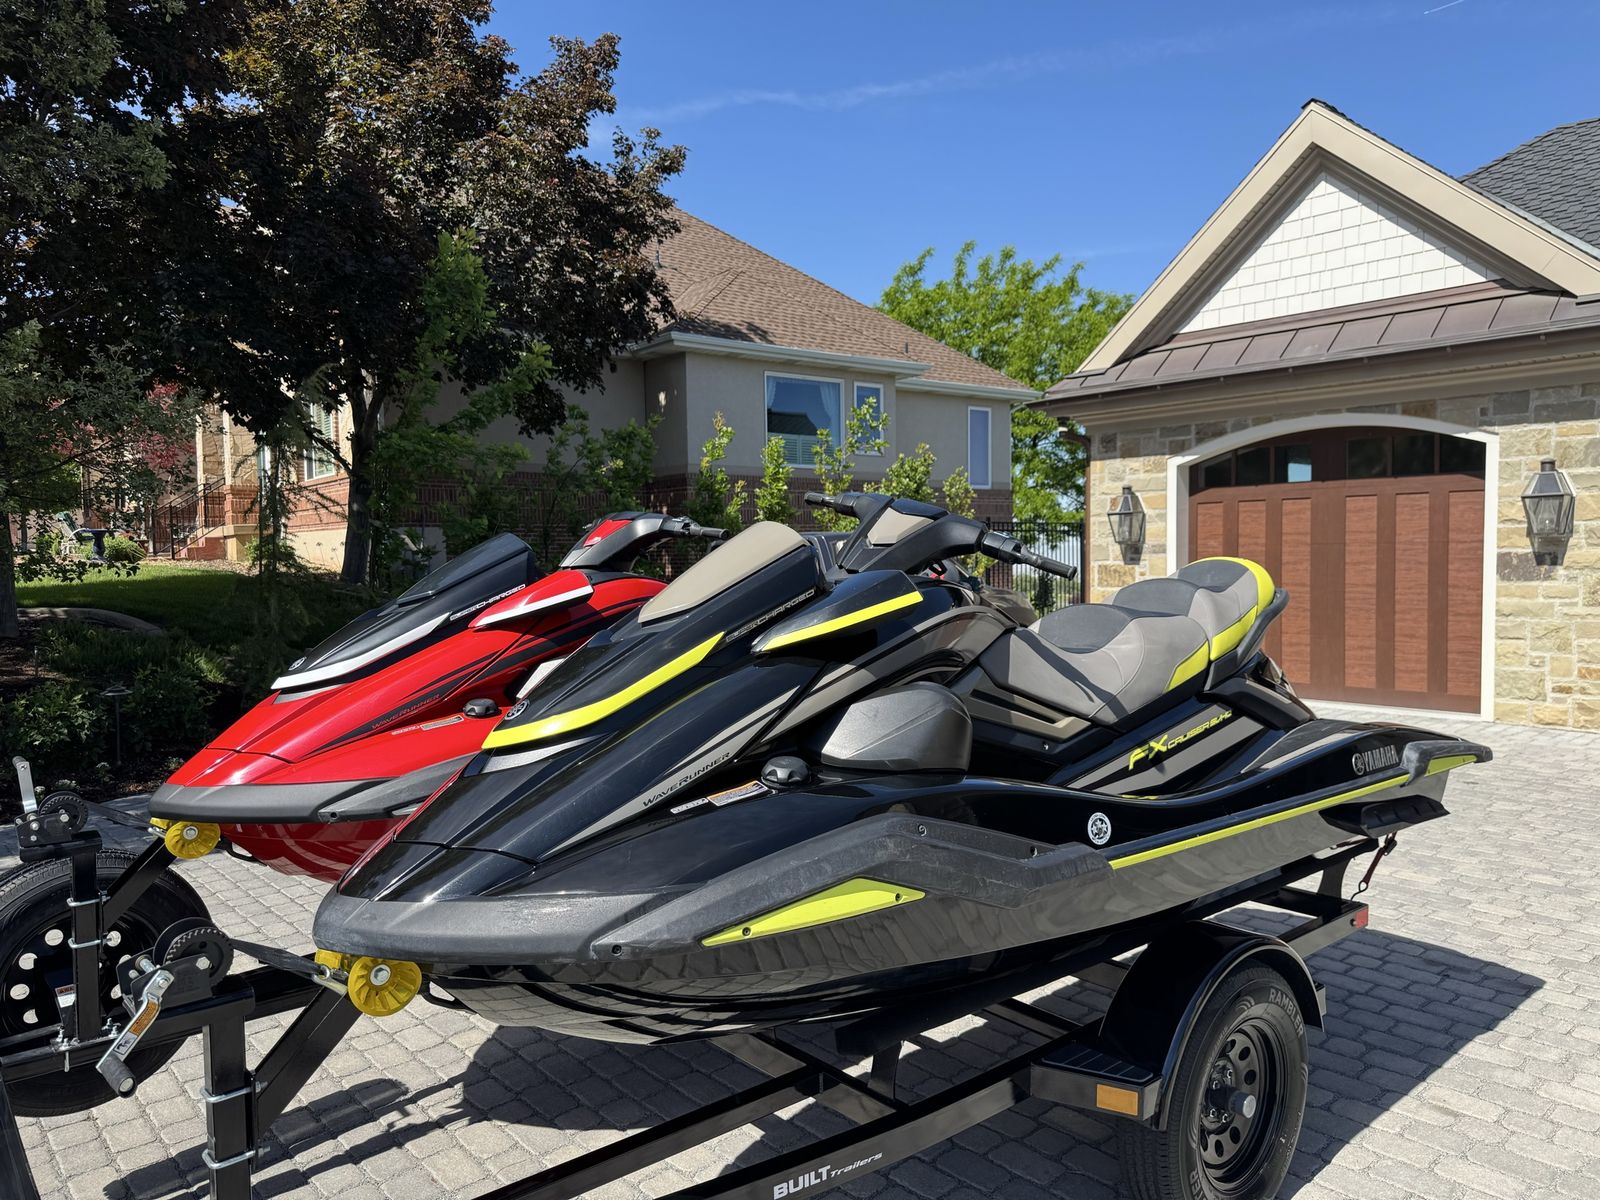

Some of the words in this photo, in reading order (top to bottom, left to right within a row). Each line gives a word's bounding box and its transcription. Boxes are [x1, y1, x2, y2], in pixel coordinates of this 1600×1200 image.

[1128, 734, 1168, 771] FX
[1362, 745, 1399, 772] YAMAHA
[642, 752, 730, 807] WAVERUNNER
[1268, 988, 1304, 1038] RAMBLER
[773, 1165, 831, 1200] BUILT
[830, 1152, 883, 1177] Trailers
